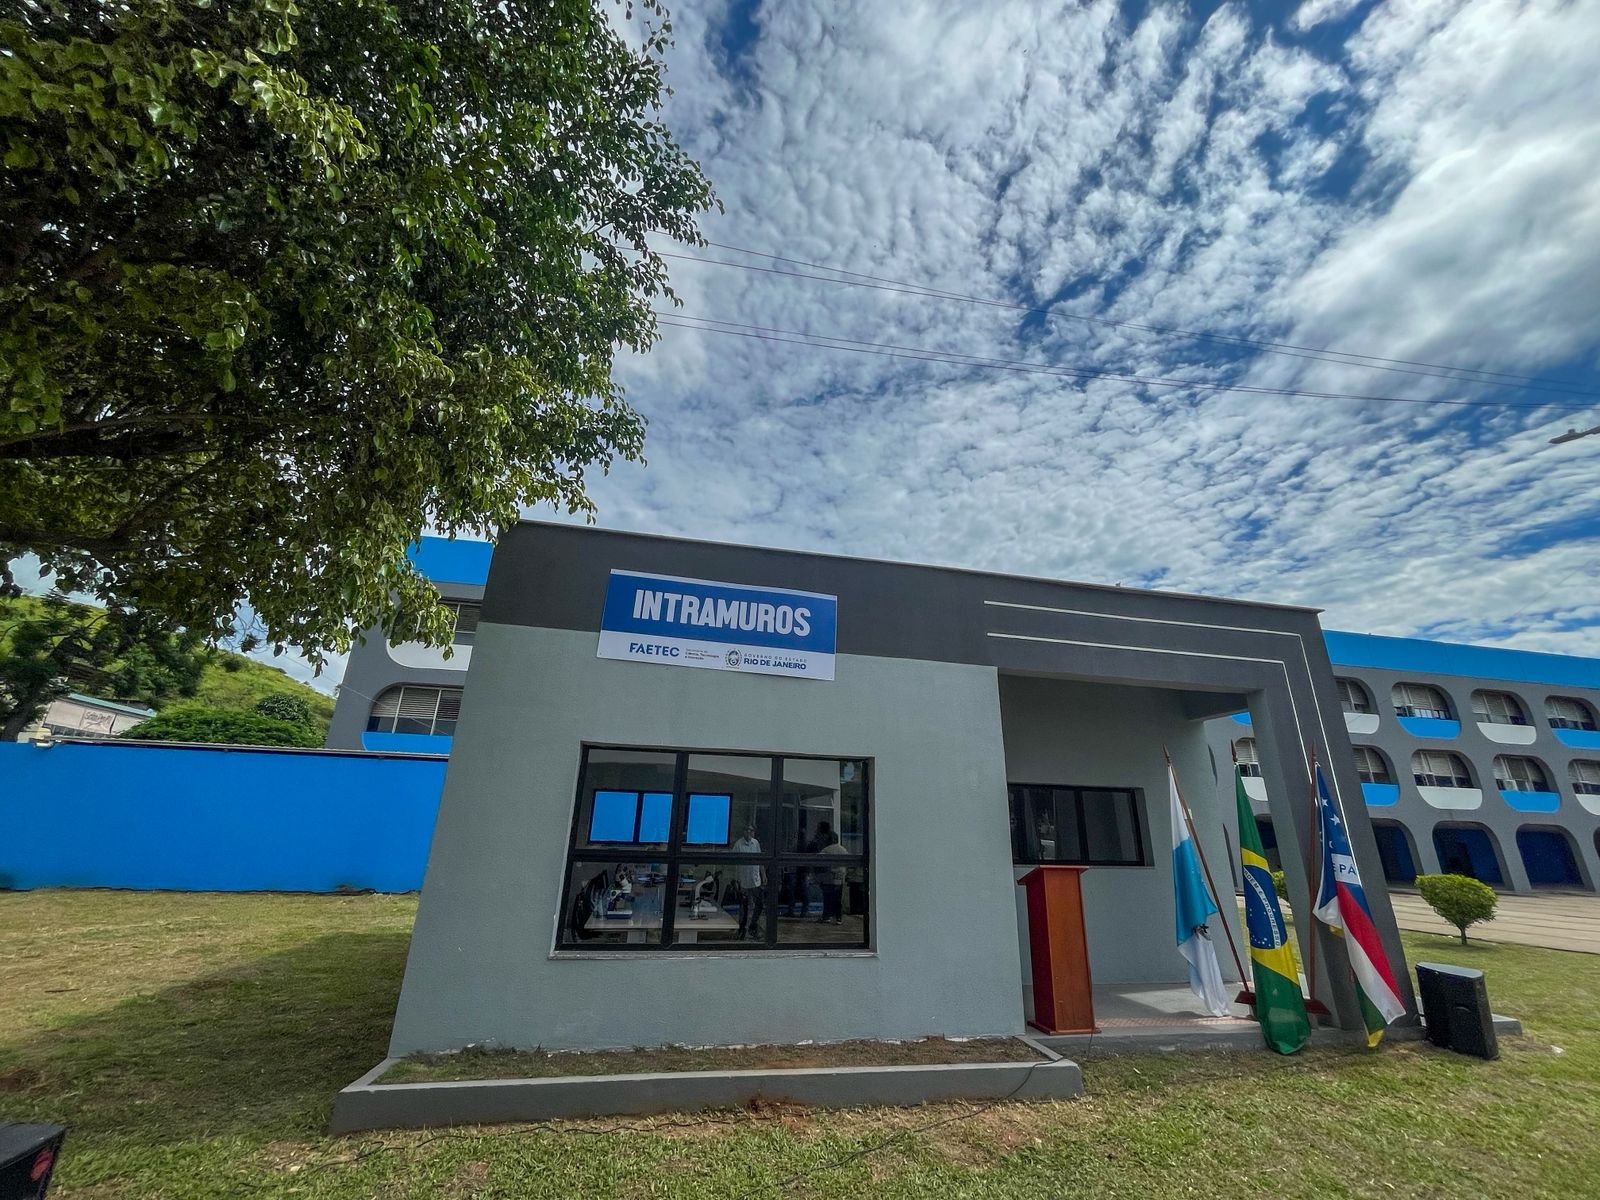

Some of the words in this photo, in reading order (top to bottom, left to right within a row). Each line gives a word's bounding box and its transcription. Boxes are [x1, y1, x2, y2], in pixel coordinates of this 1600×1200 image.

[632, 589, 812, 637] INTRAMUROS
[629, 642, 680, 657] FAETEC
[743, 657, 759, 665] RIO
[772, 660, 807, 670] JANEIRO
